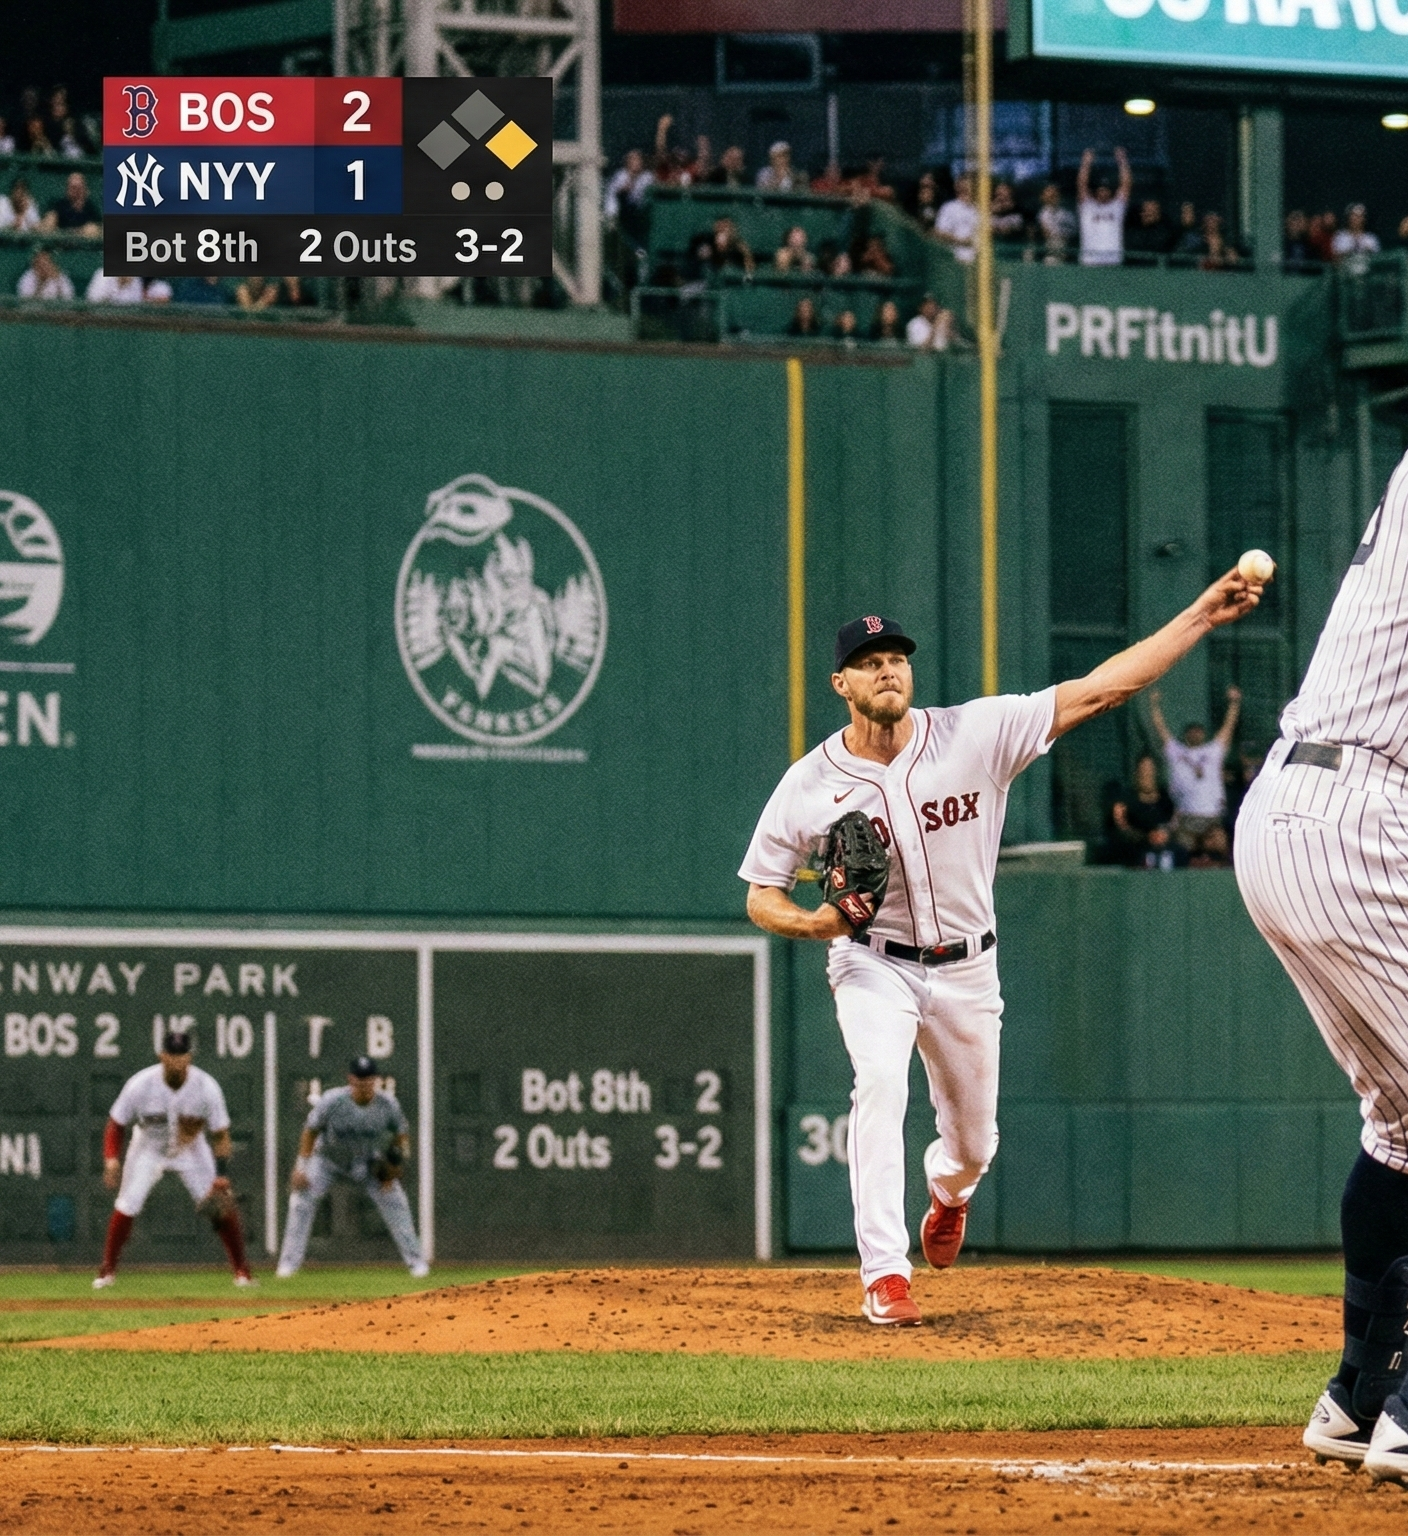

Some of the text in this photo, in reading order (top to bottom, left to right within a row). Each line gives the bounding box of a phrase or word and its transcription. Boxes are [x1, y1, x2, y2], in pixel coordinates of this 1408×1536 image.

[920, 791, 981, 833] SOX
[0, 962, 299, 998] NWAY PARK
[4, 1012, 79, 1057] BOS
[94, 1012, 120, 1057] 2
[522, 1068, 721, 1113] Bot 8th 2
[493, 1124, 722, 1169] 2 Outs 3-2
